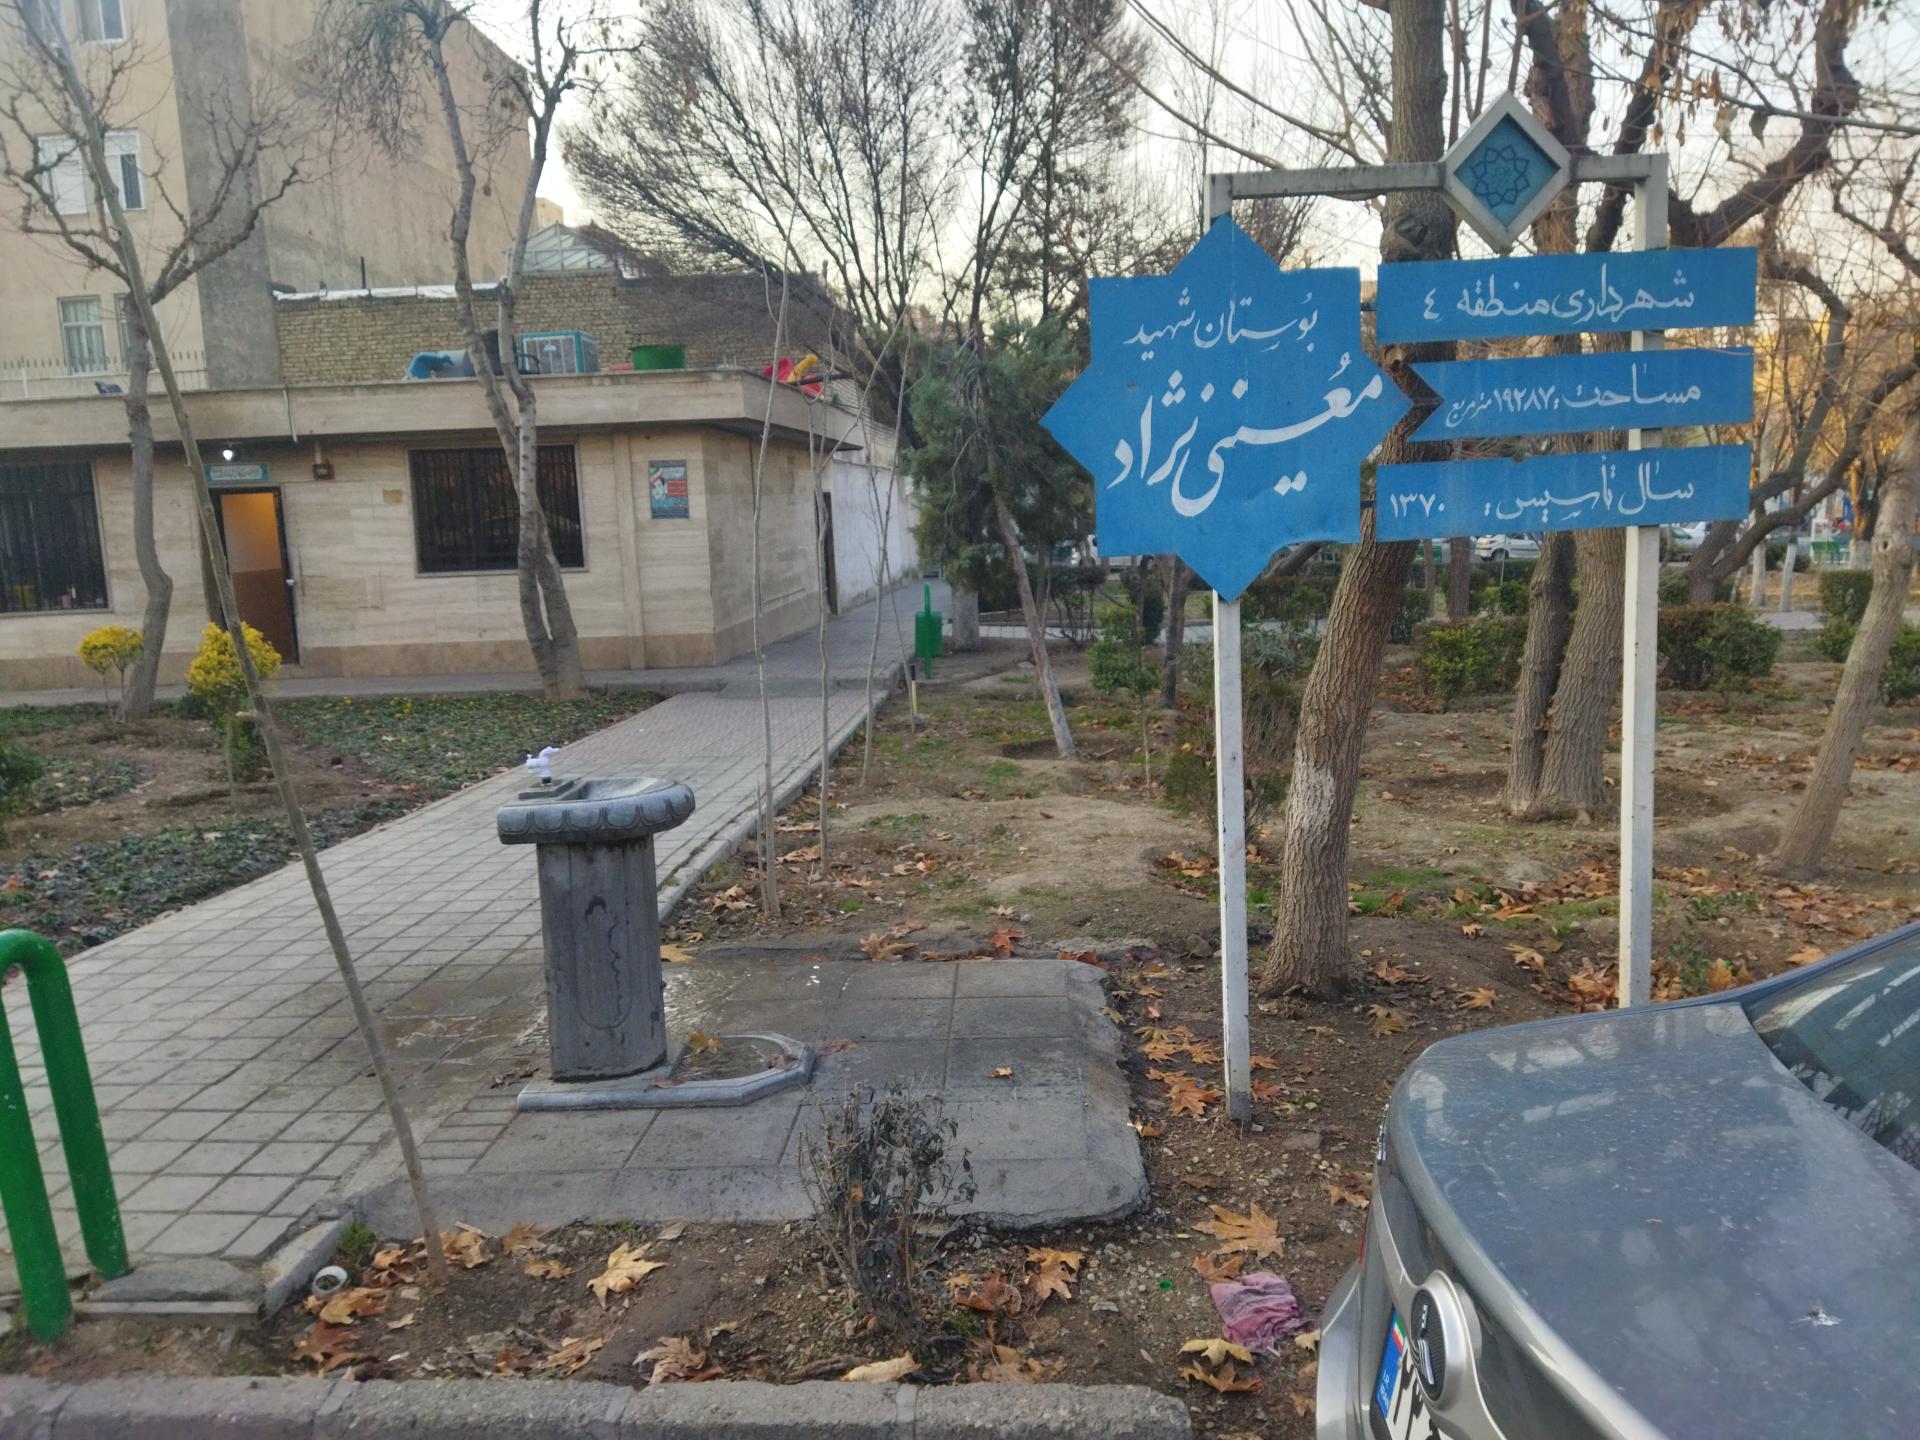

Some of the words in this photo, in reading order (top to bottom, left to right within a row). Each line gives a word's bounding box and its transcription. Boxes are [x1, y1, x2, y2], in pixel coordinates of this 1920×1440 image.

[1456, 272, 1551, 317] منطقه
[1551, 262, 1695, 325] شهرداری
[1123, 287, 1196, 360] شهید
[1488, 384, 1555, 412] ۱۹۲۸۷
[1106, 370, 1214, 490] نژاد
[1389, 493, 1446, 519] ۱۳۷۰
[1618, 460, 1694, 515] سال
